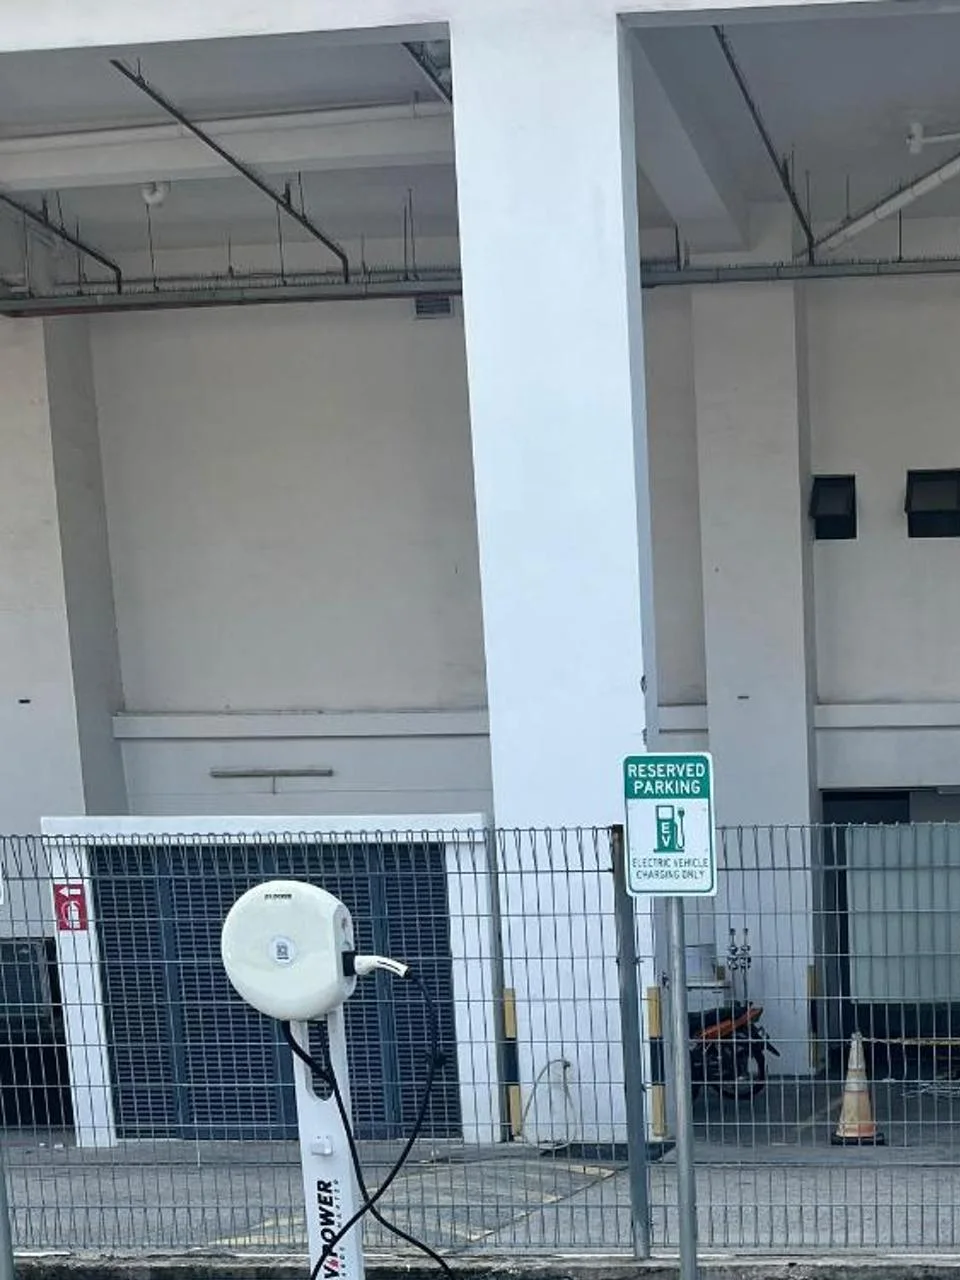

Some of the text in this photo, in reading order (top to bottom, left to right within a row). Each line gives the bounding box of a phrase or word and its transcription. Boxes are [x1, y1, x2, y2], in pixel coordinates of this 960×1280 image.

[627, 763, 706, 778] RESERVED
[634, 780, 701, 794] PARKING
[661, 822, 671, 847] EV
[632, 857, 708, 868] ELECTRIC VEHICLE
[636, 870, 705, 880] CHARGING ONLY
